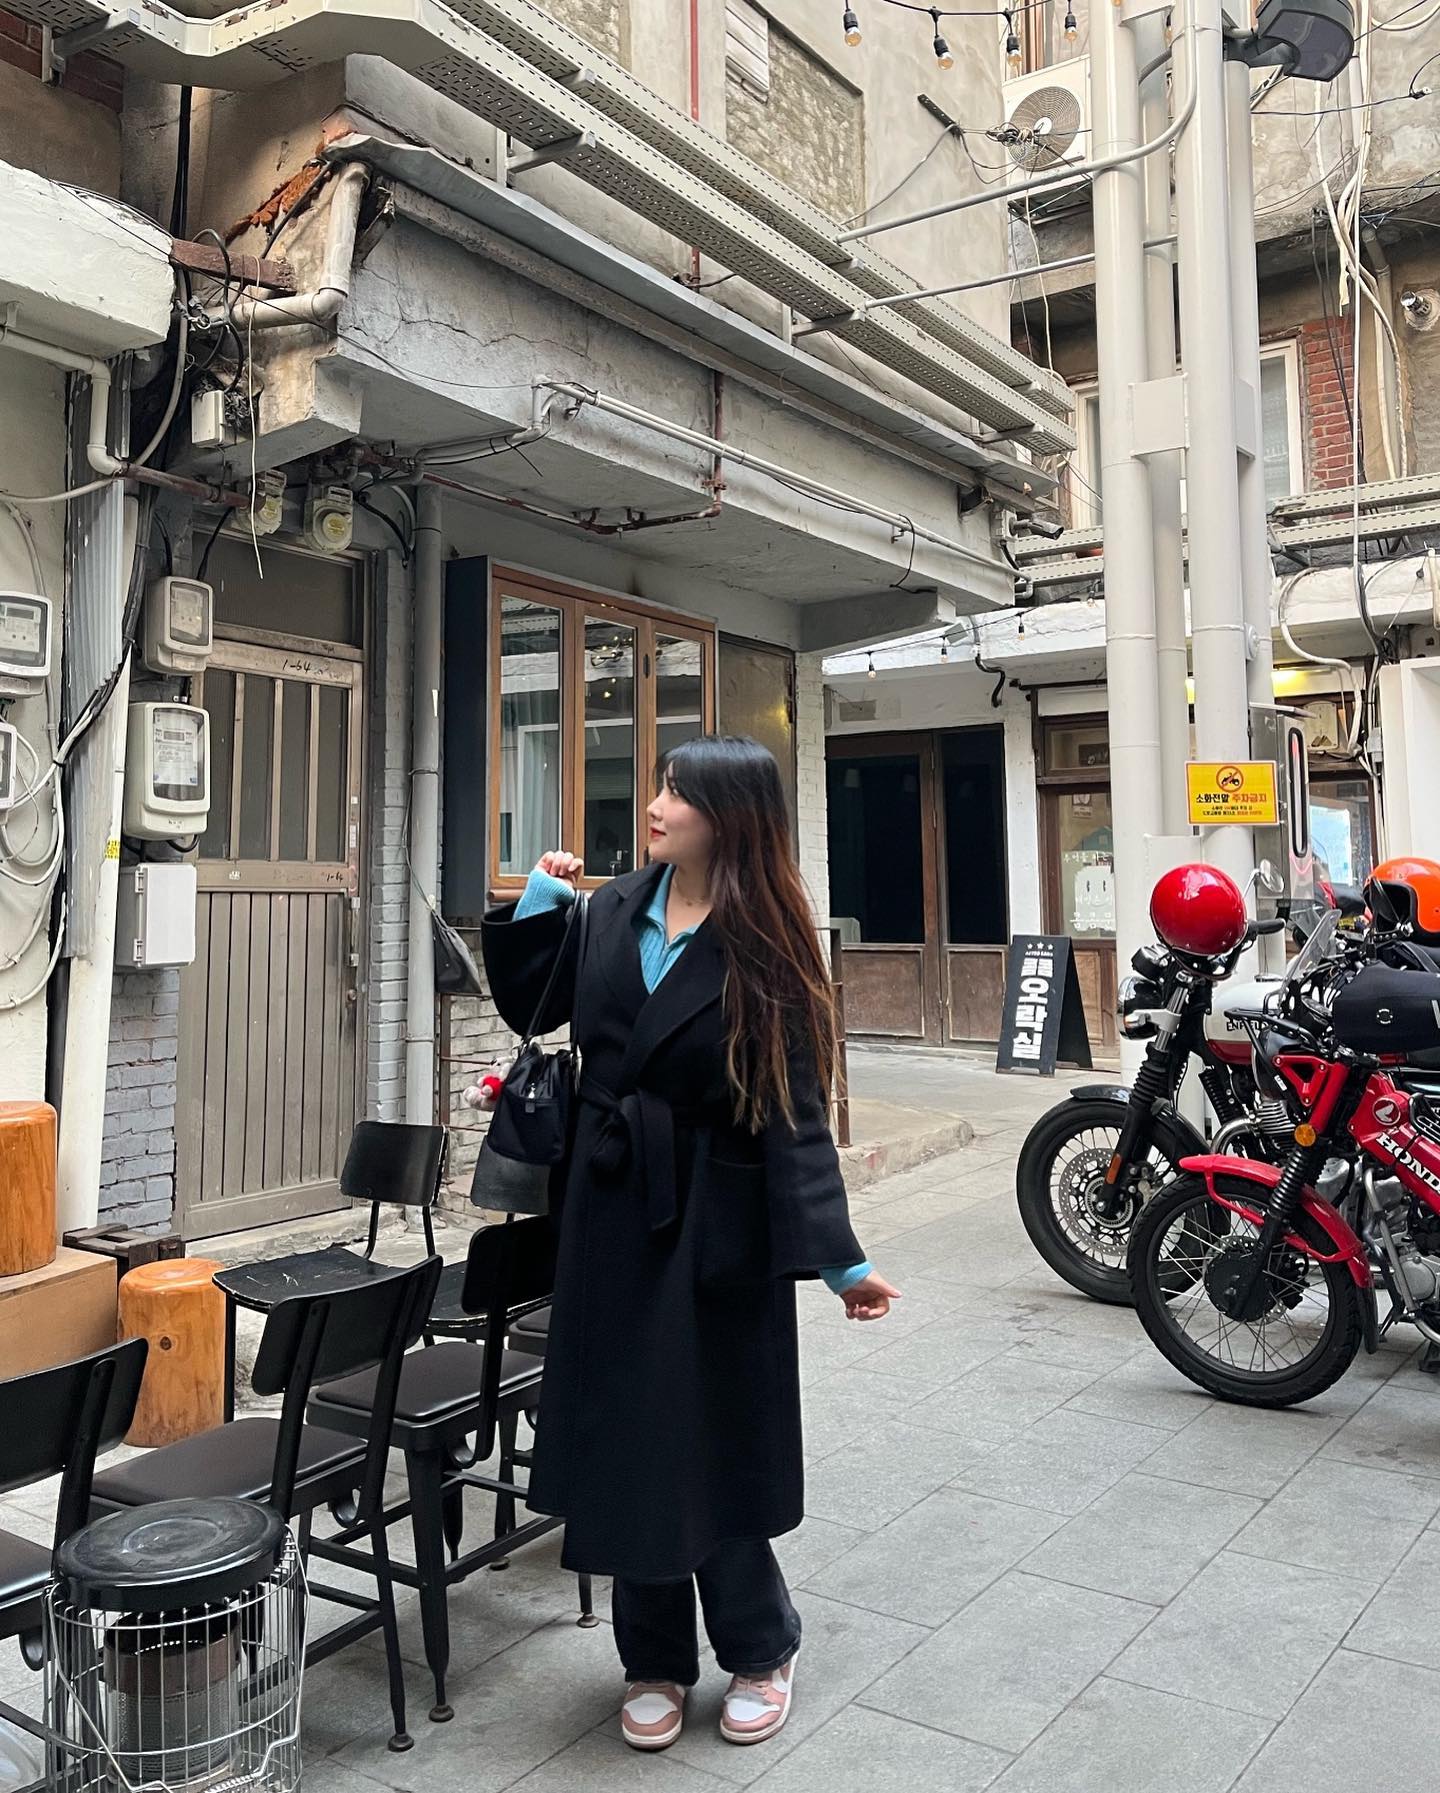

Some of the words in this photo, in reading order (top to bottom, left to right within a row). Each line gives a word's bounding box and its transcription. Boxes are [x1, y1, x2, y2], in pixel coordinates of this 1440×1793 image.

[282, 659, 311, 674] 1-64
[1232, 793, 1267, 803] 주차금지
[1226, 1019, 1268, 1032] ENFELD
[1376, 1132, 1440, 1194] HOND
